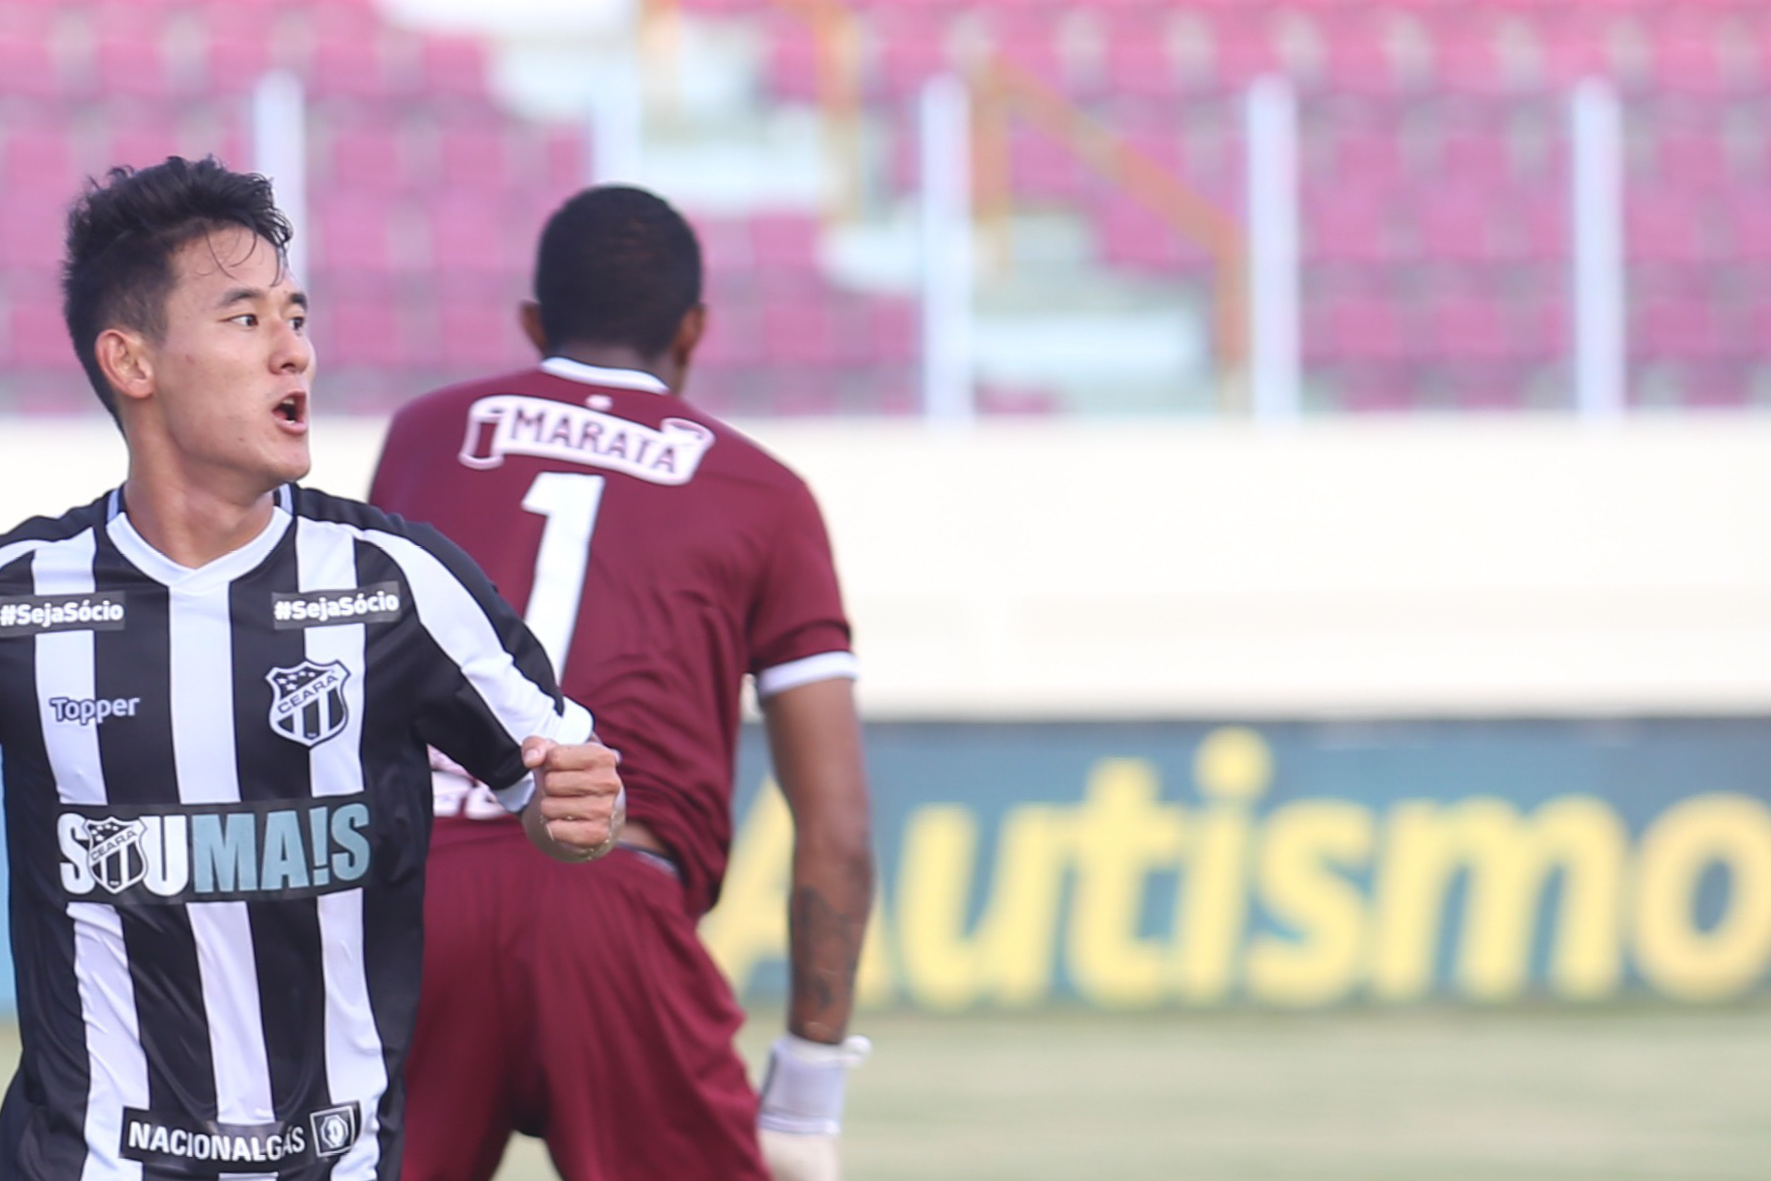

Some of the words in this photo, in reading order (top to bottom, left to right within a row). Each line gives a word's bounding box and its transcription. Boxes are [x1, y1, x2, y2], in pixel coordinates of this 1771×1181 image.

[522, 471, 605, 692] 1
[273, 592, 400, 620] #SejaSócio
[49, 696, 141, 726] Topper
